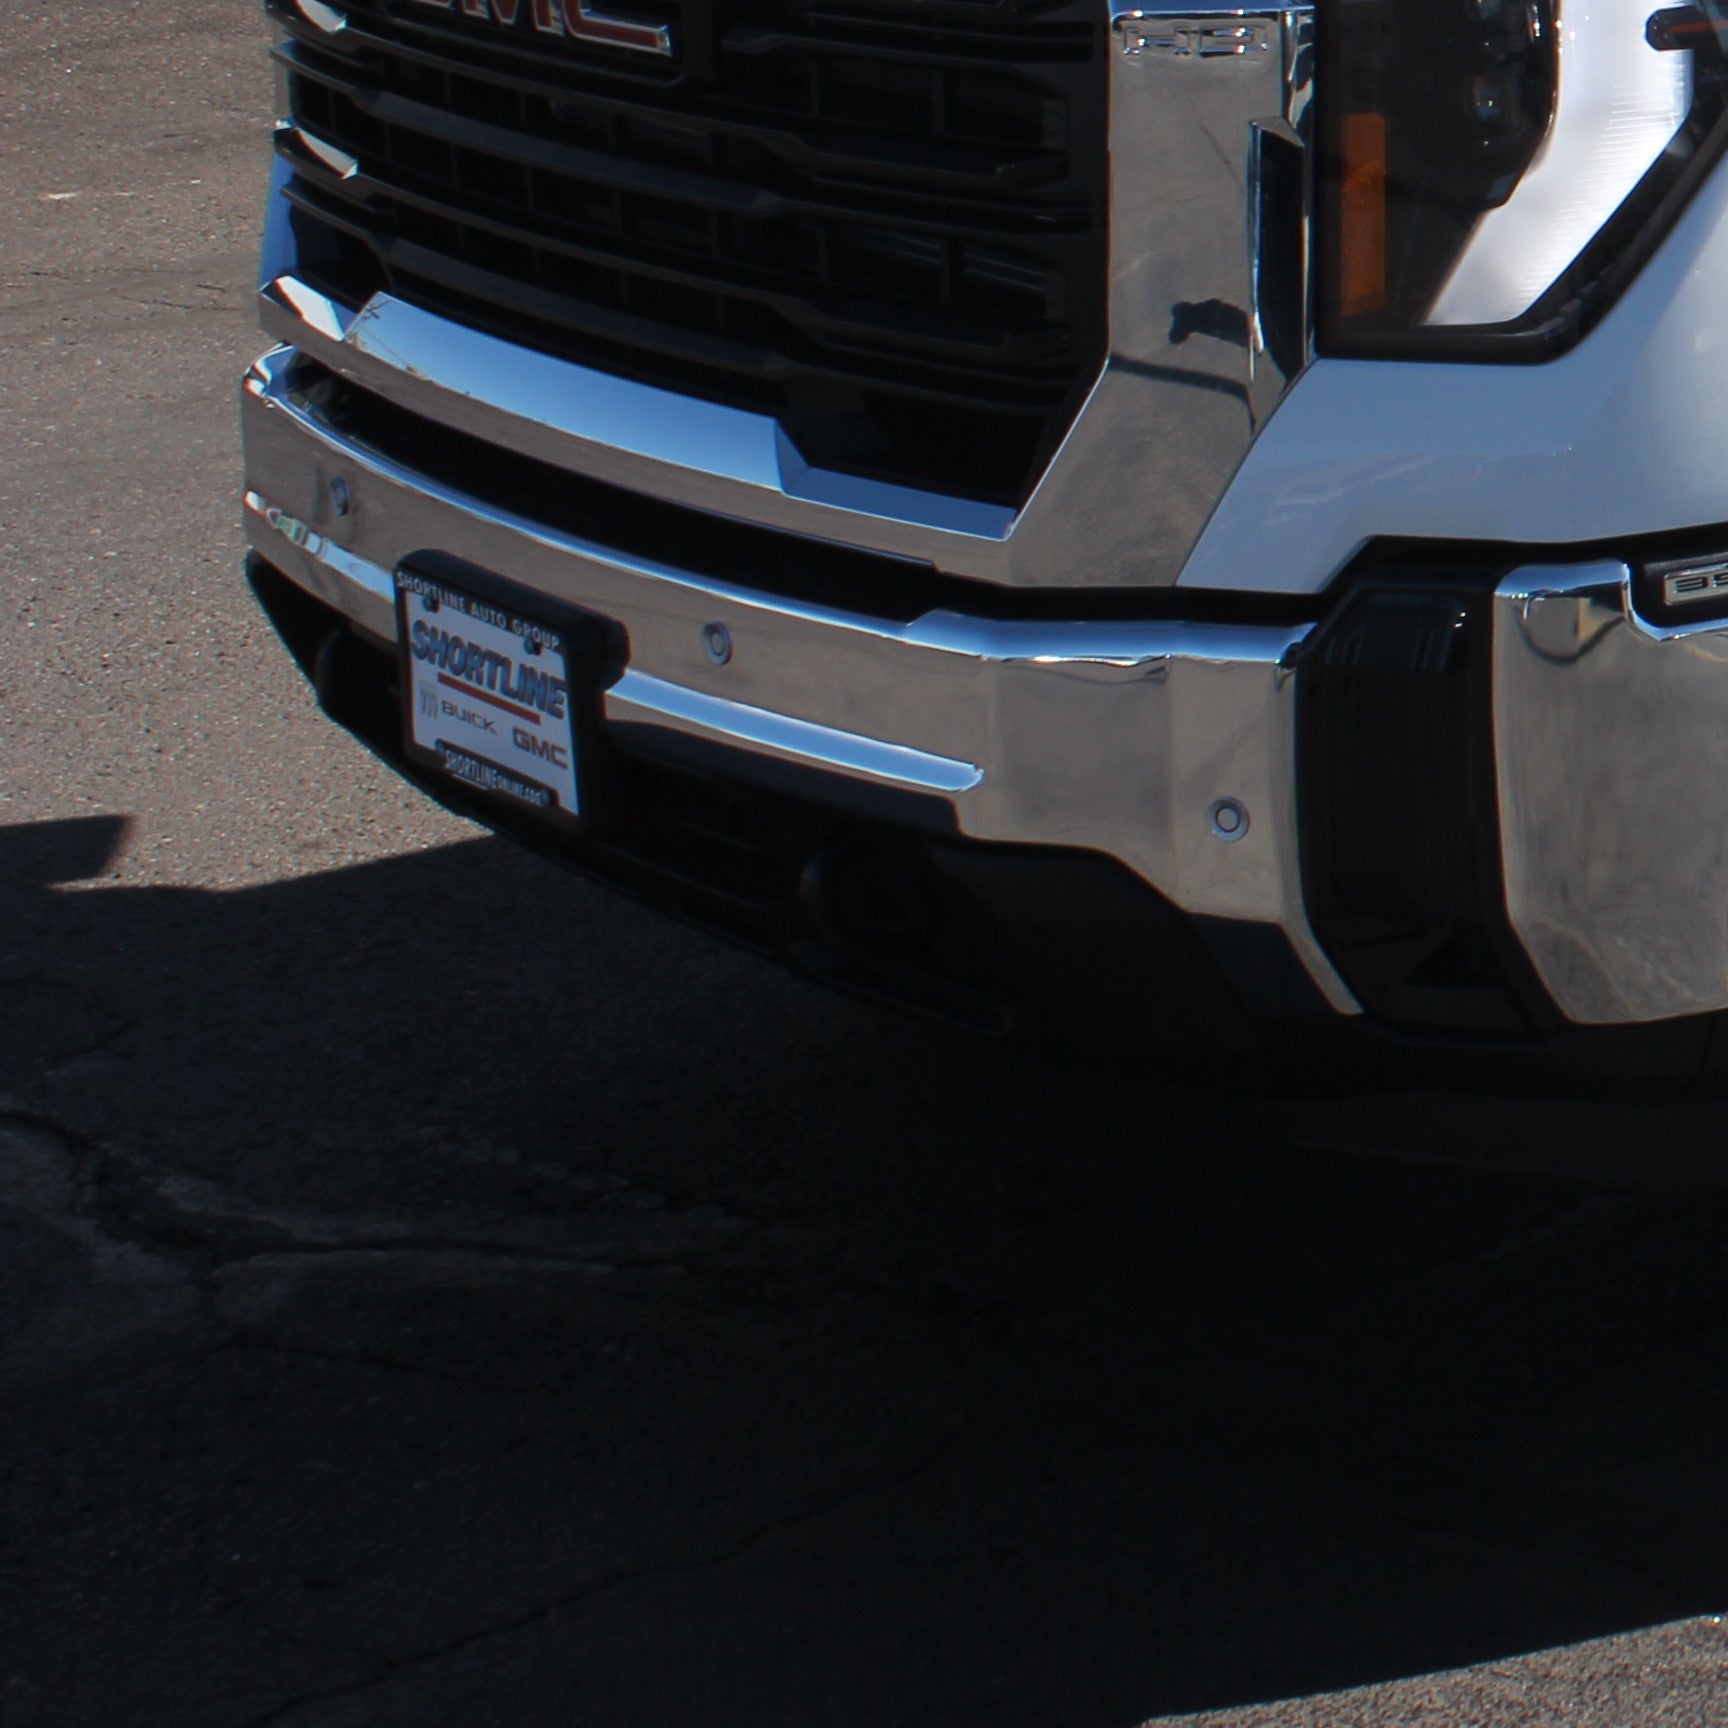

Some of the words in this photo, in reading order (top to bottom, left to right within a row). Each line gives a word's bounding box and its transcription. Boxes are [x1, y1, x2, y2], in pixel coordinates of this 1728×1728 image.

[470, 601, 507, 630] AUTO
[511, 618, 560, 650] GROUP
[410, 618, 567, 720] SHORTLINE
[442, 699, 498, 735] BUICK
[512, 725, 570, 770] GMC
